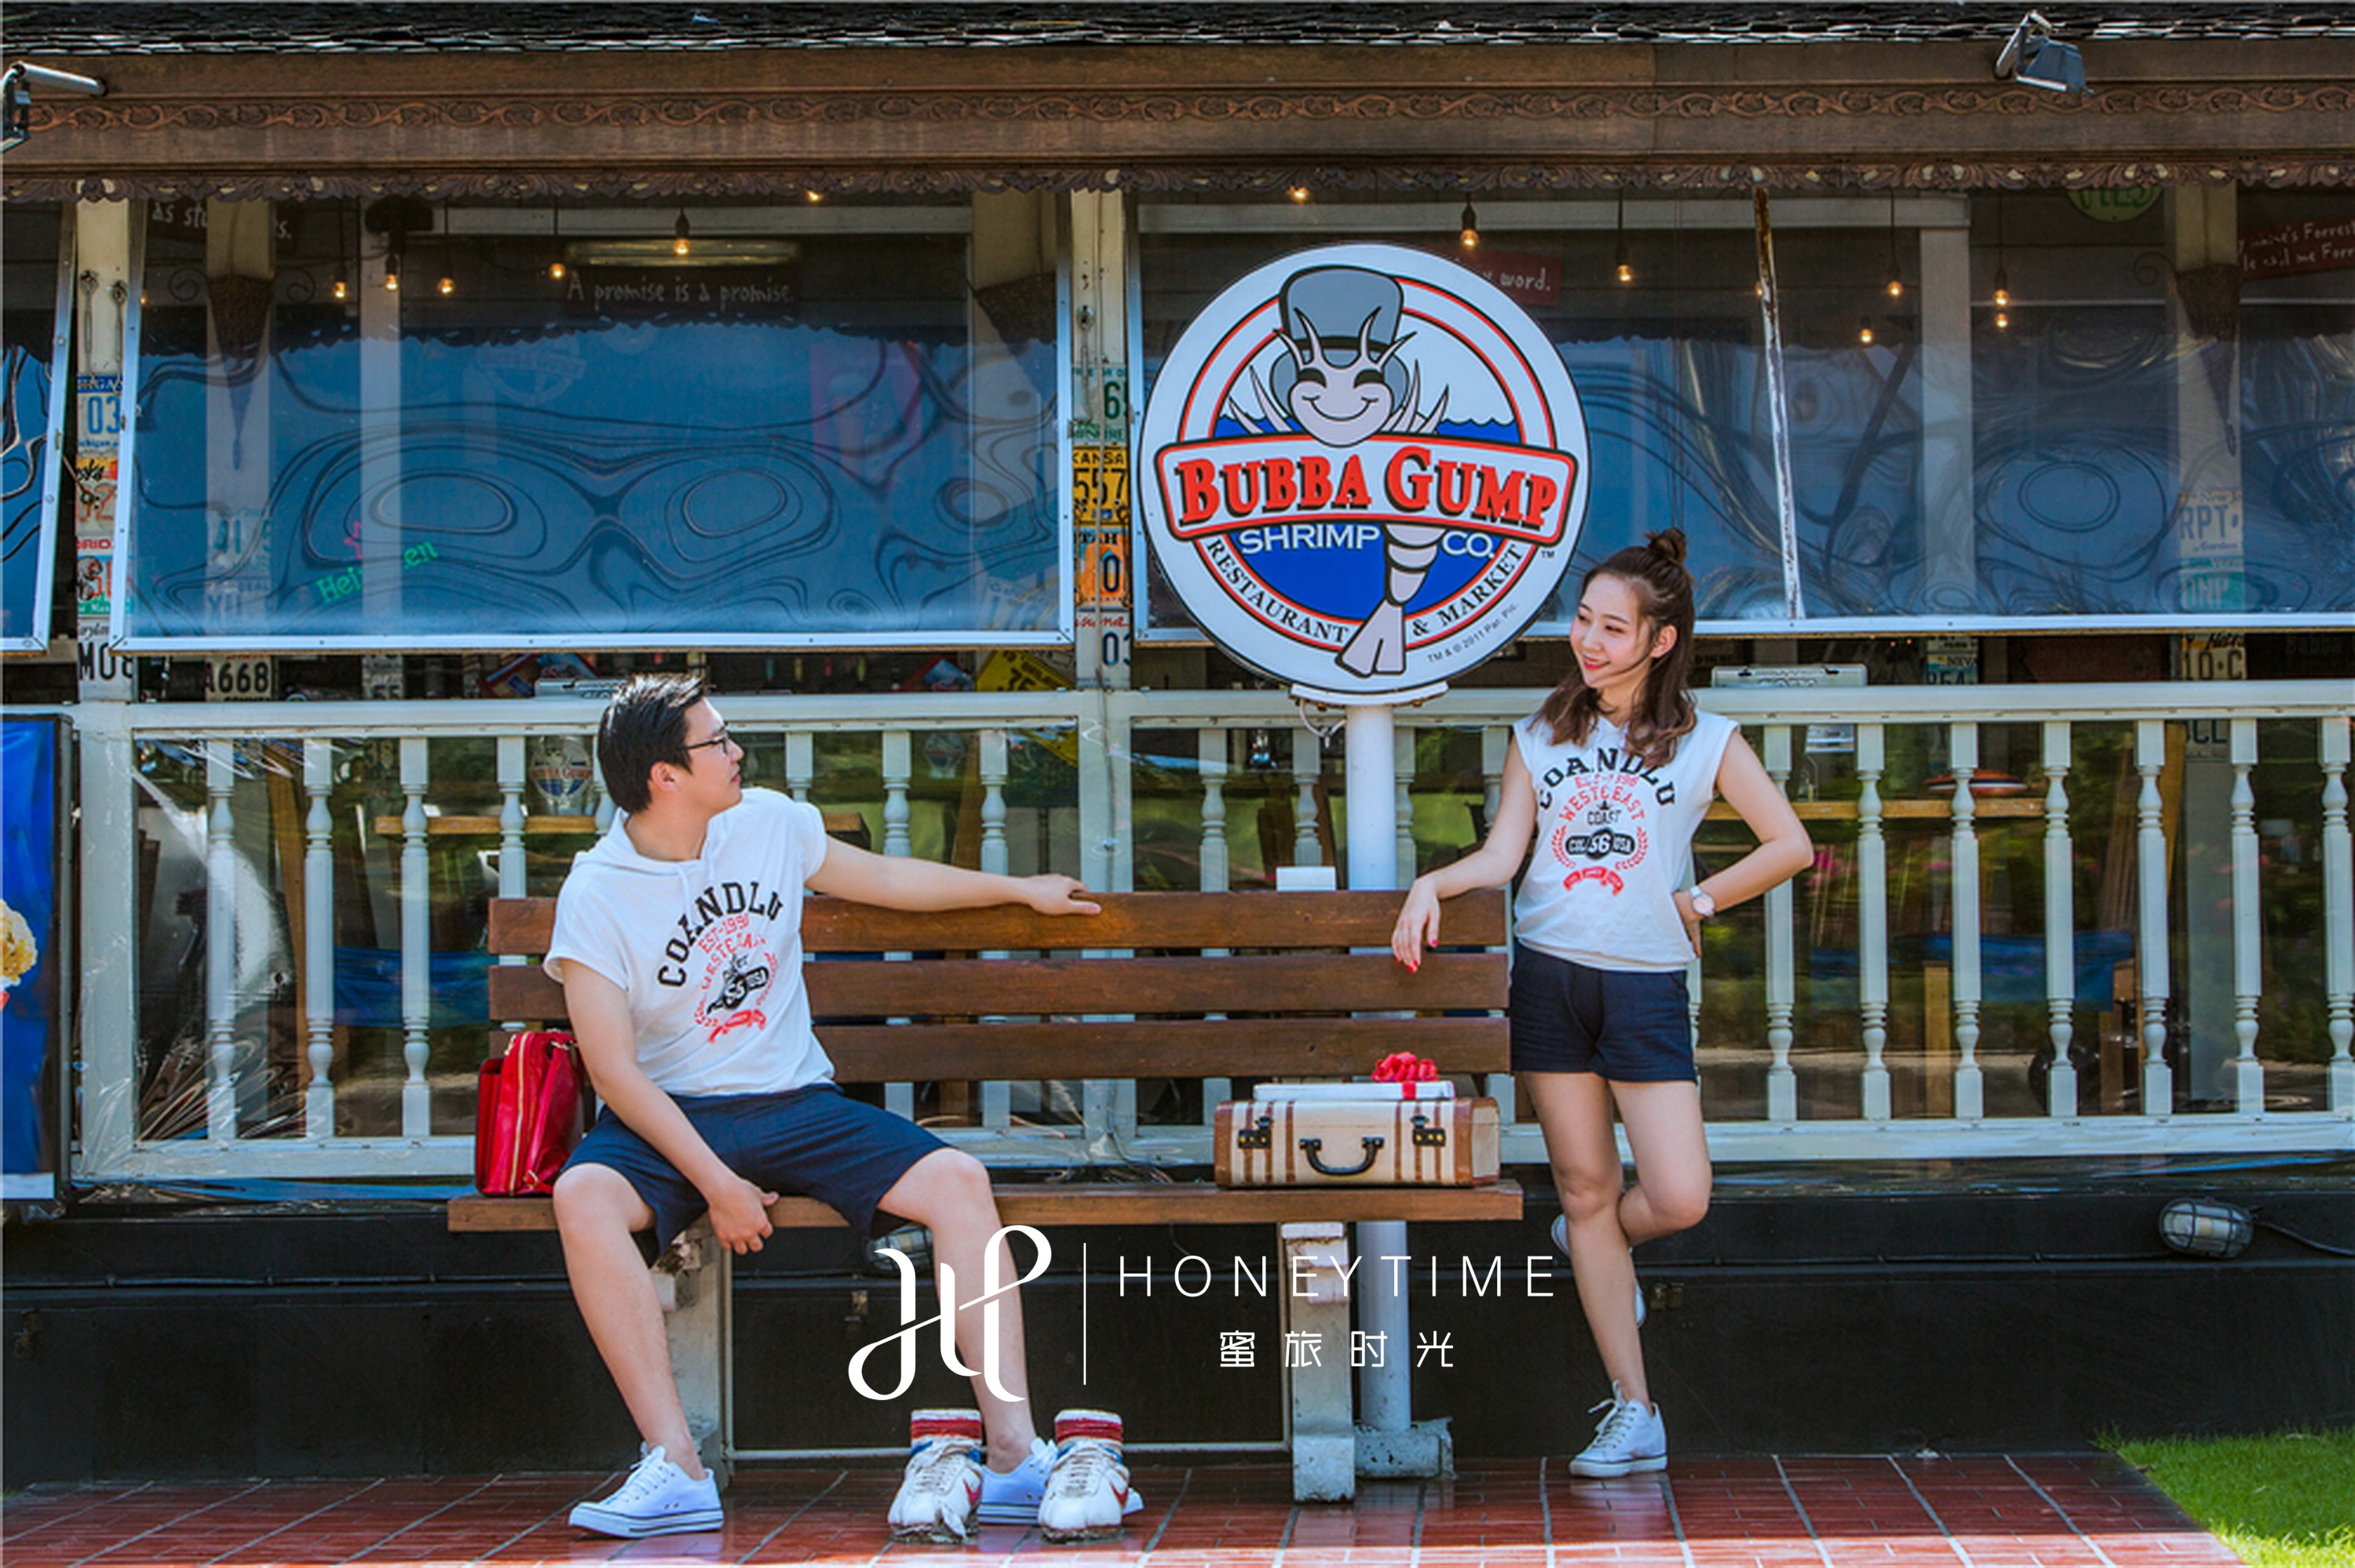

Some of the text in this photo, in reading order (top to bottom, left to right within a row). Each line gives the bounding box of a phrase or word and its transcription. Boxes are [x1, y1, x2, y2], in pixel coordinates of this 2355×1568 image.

[568, 272, 584, 301] A
[594, 276, 665, 312] promise
[676, 277, 689, 302] is
[1176, 445, 1558, 531] BUBBA GUMP
[1239, 523, 1495, 560] SHRIMP CO.
[1206, 539, 1349, 644] RESTAURANT
[1437, 544, 1527, 628] MARKET
